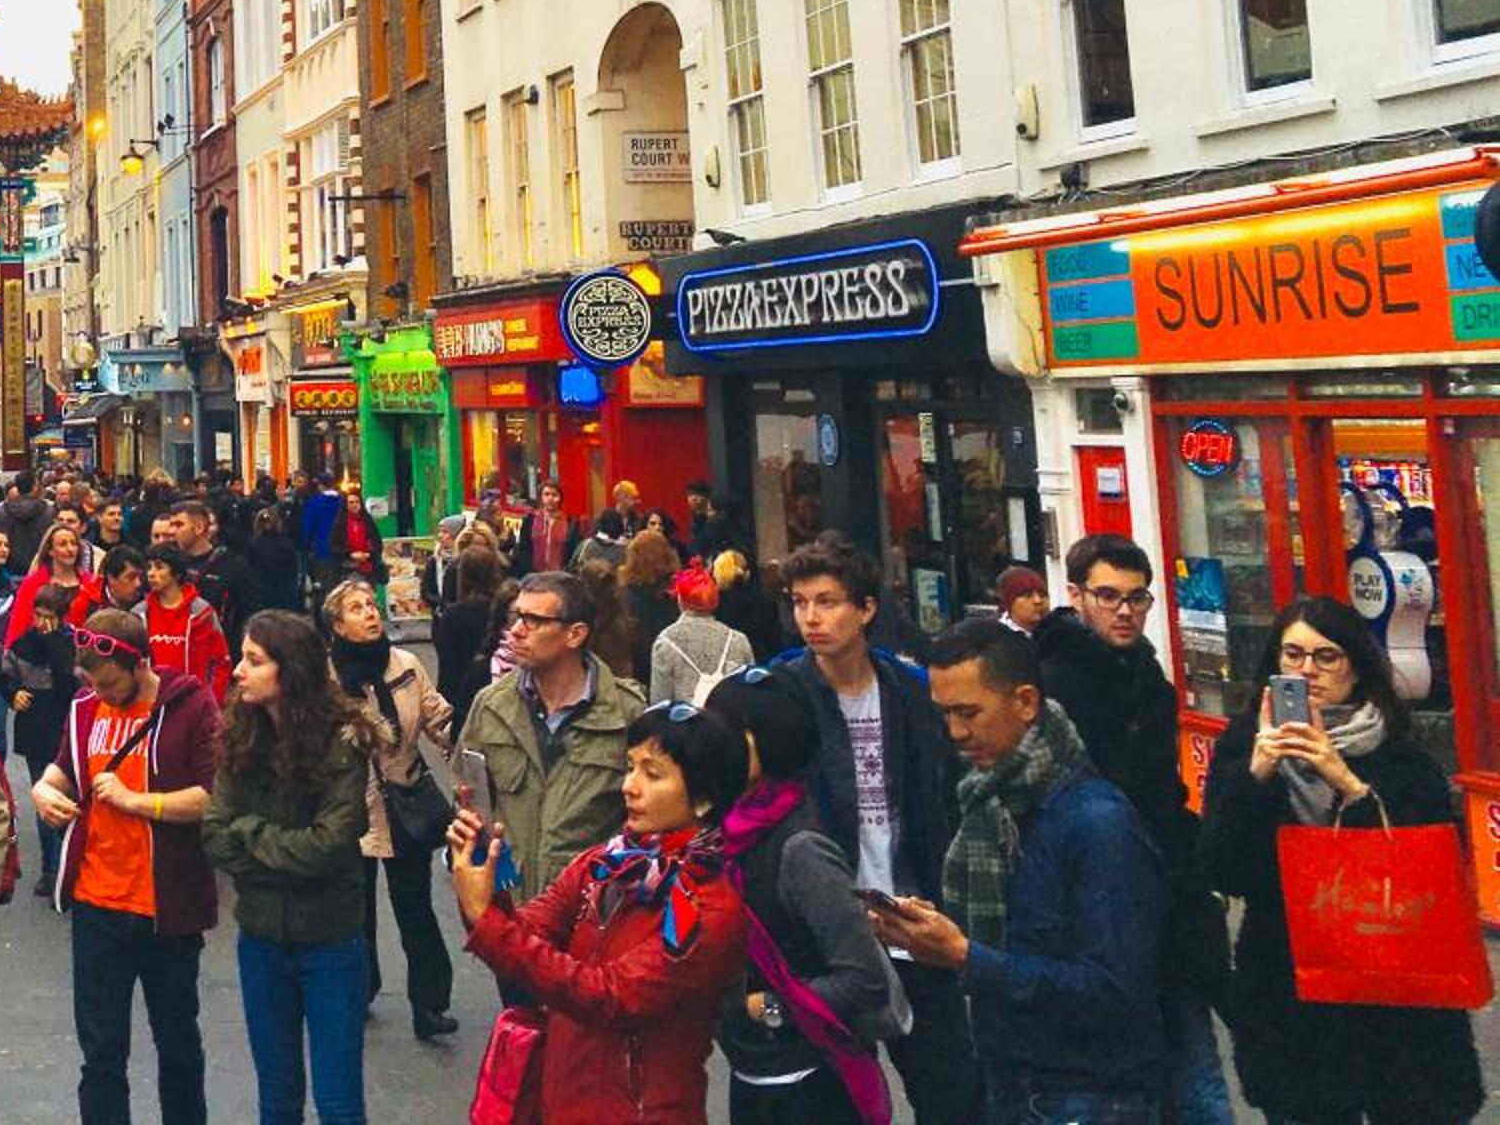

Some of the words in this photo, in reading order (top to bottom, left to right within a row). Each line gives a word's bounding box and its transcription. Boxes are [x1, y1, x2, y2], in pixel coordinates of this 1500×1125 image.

[630, 138, 679, 151] RUPERT
[630, 152, 674, 166] COURT
[620, 221, 690, 237] RUPERT
[628, 237, 689, 251] COURT
[1154, 227, 1420, 332] SUNRISE
[588, 306, 629, 317] PIZZA
[577, 316, 643, 328] EXPRESS
[1181, 431, 1234, 464] OPEN
[1353, 572, 1382, 588] PLAY
[1355, 588, 1383, 602] NOW
